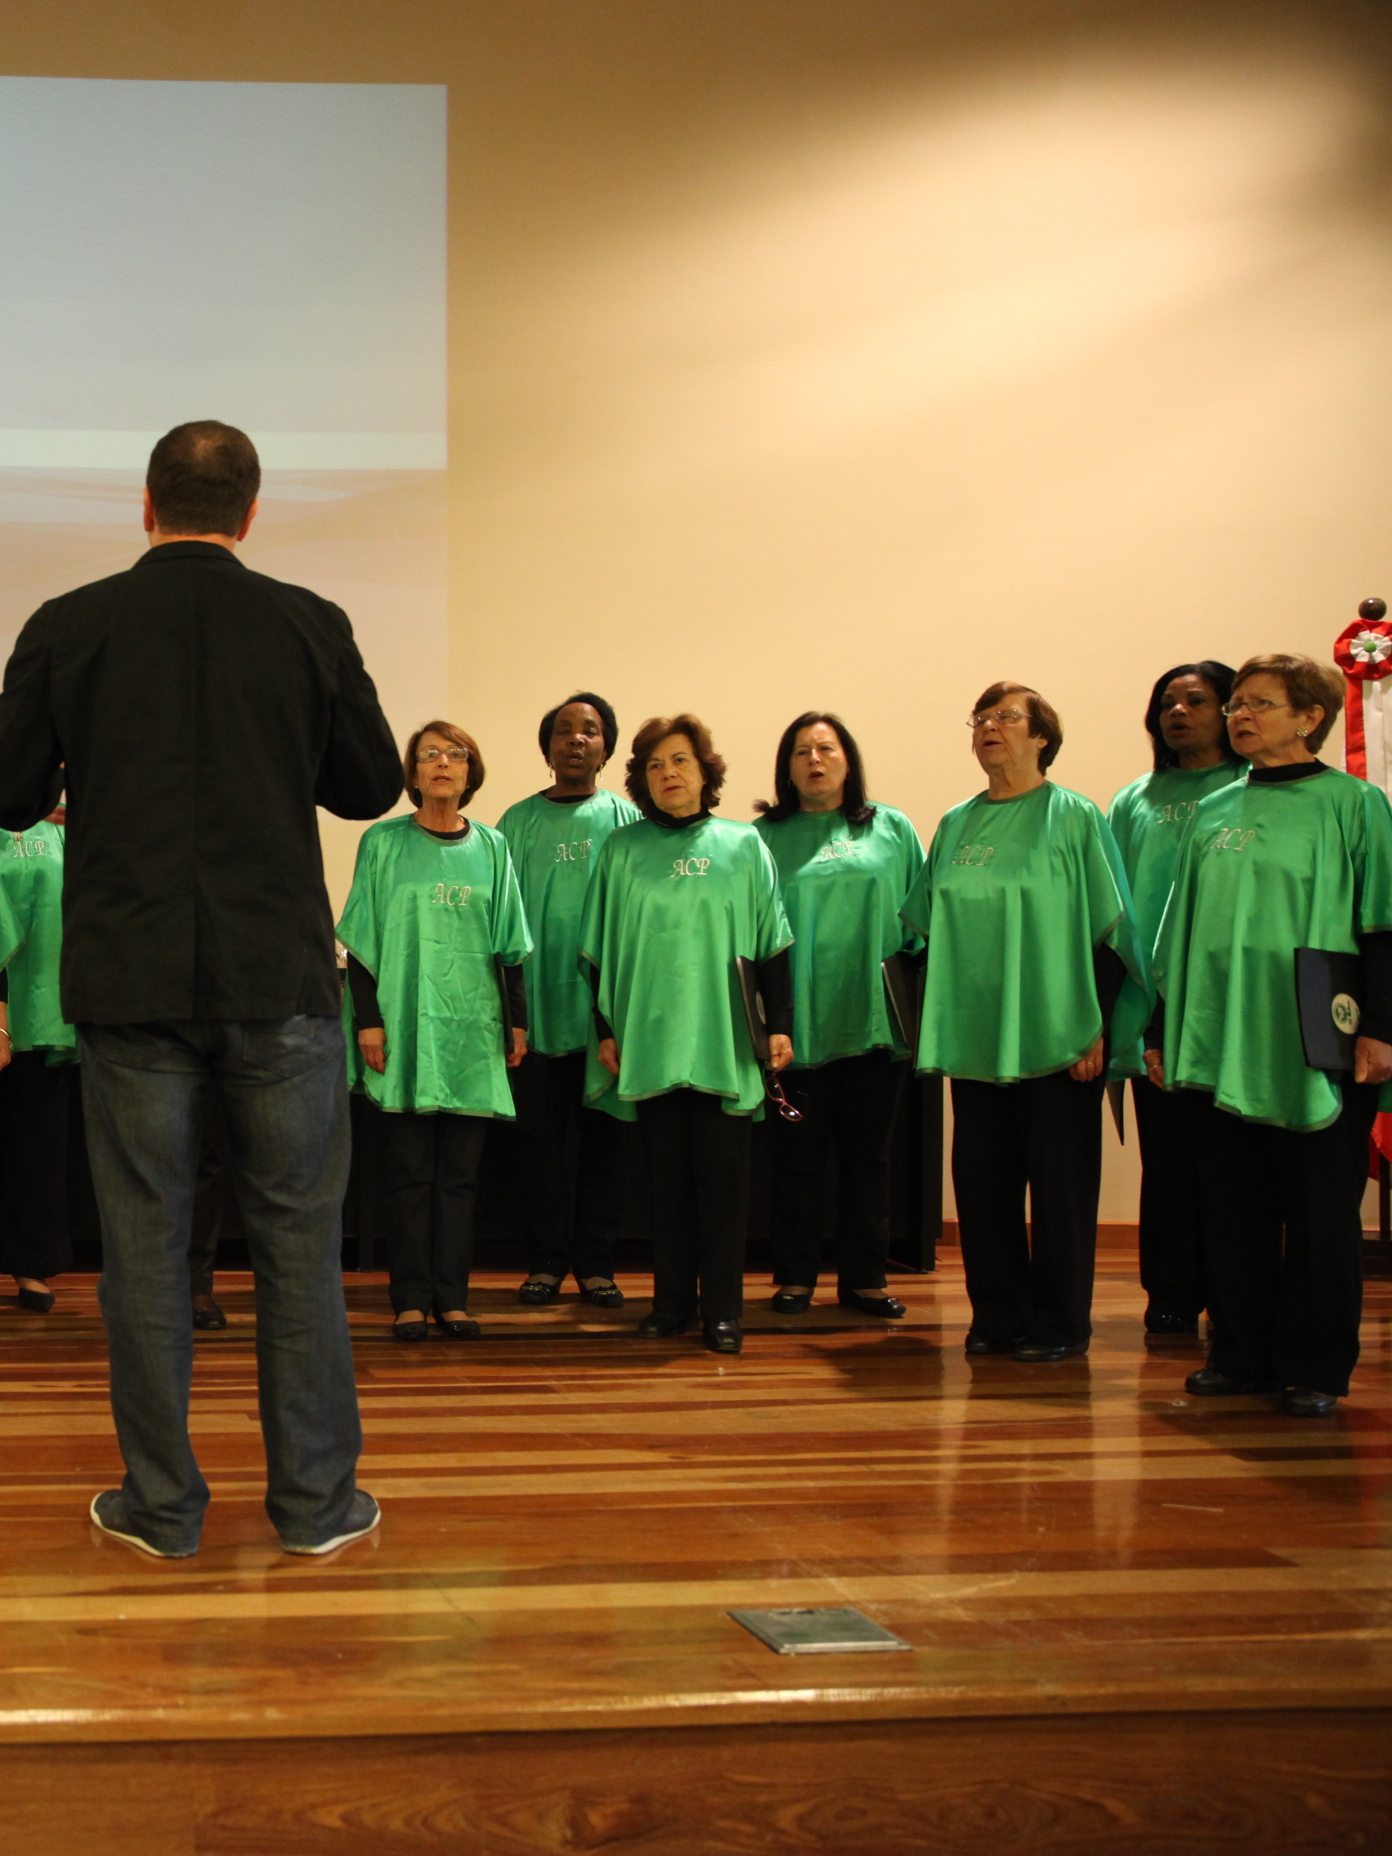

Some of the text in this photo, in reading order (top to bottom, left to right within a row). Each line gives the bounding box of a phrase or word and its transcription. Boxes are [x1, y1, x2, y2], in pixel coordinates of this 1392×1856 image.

[13, 840, 45, 858] ACP
[554, 839, 593, 863] ACP
[819, 840, 855, 862] ACP
[670, 857, 712, 878] ACP
[431, 882, 472, 907] ACP
